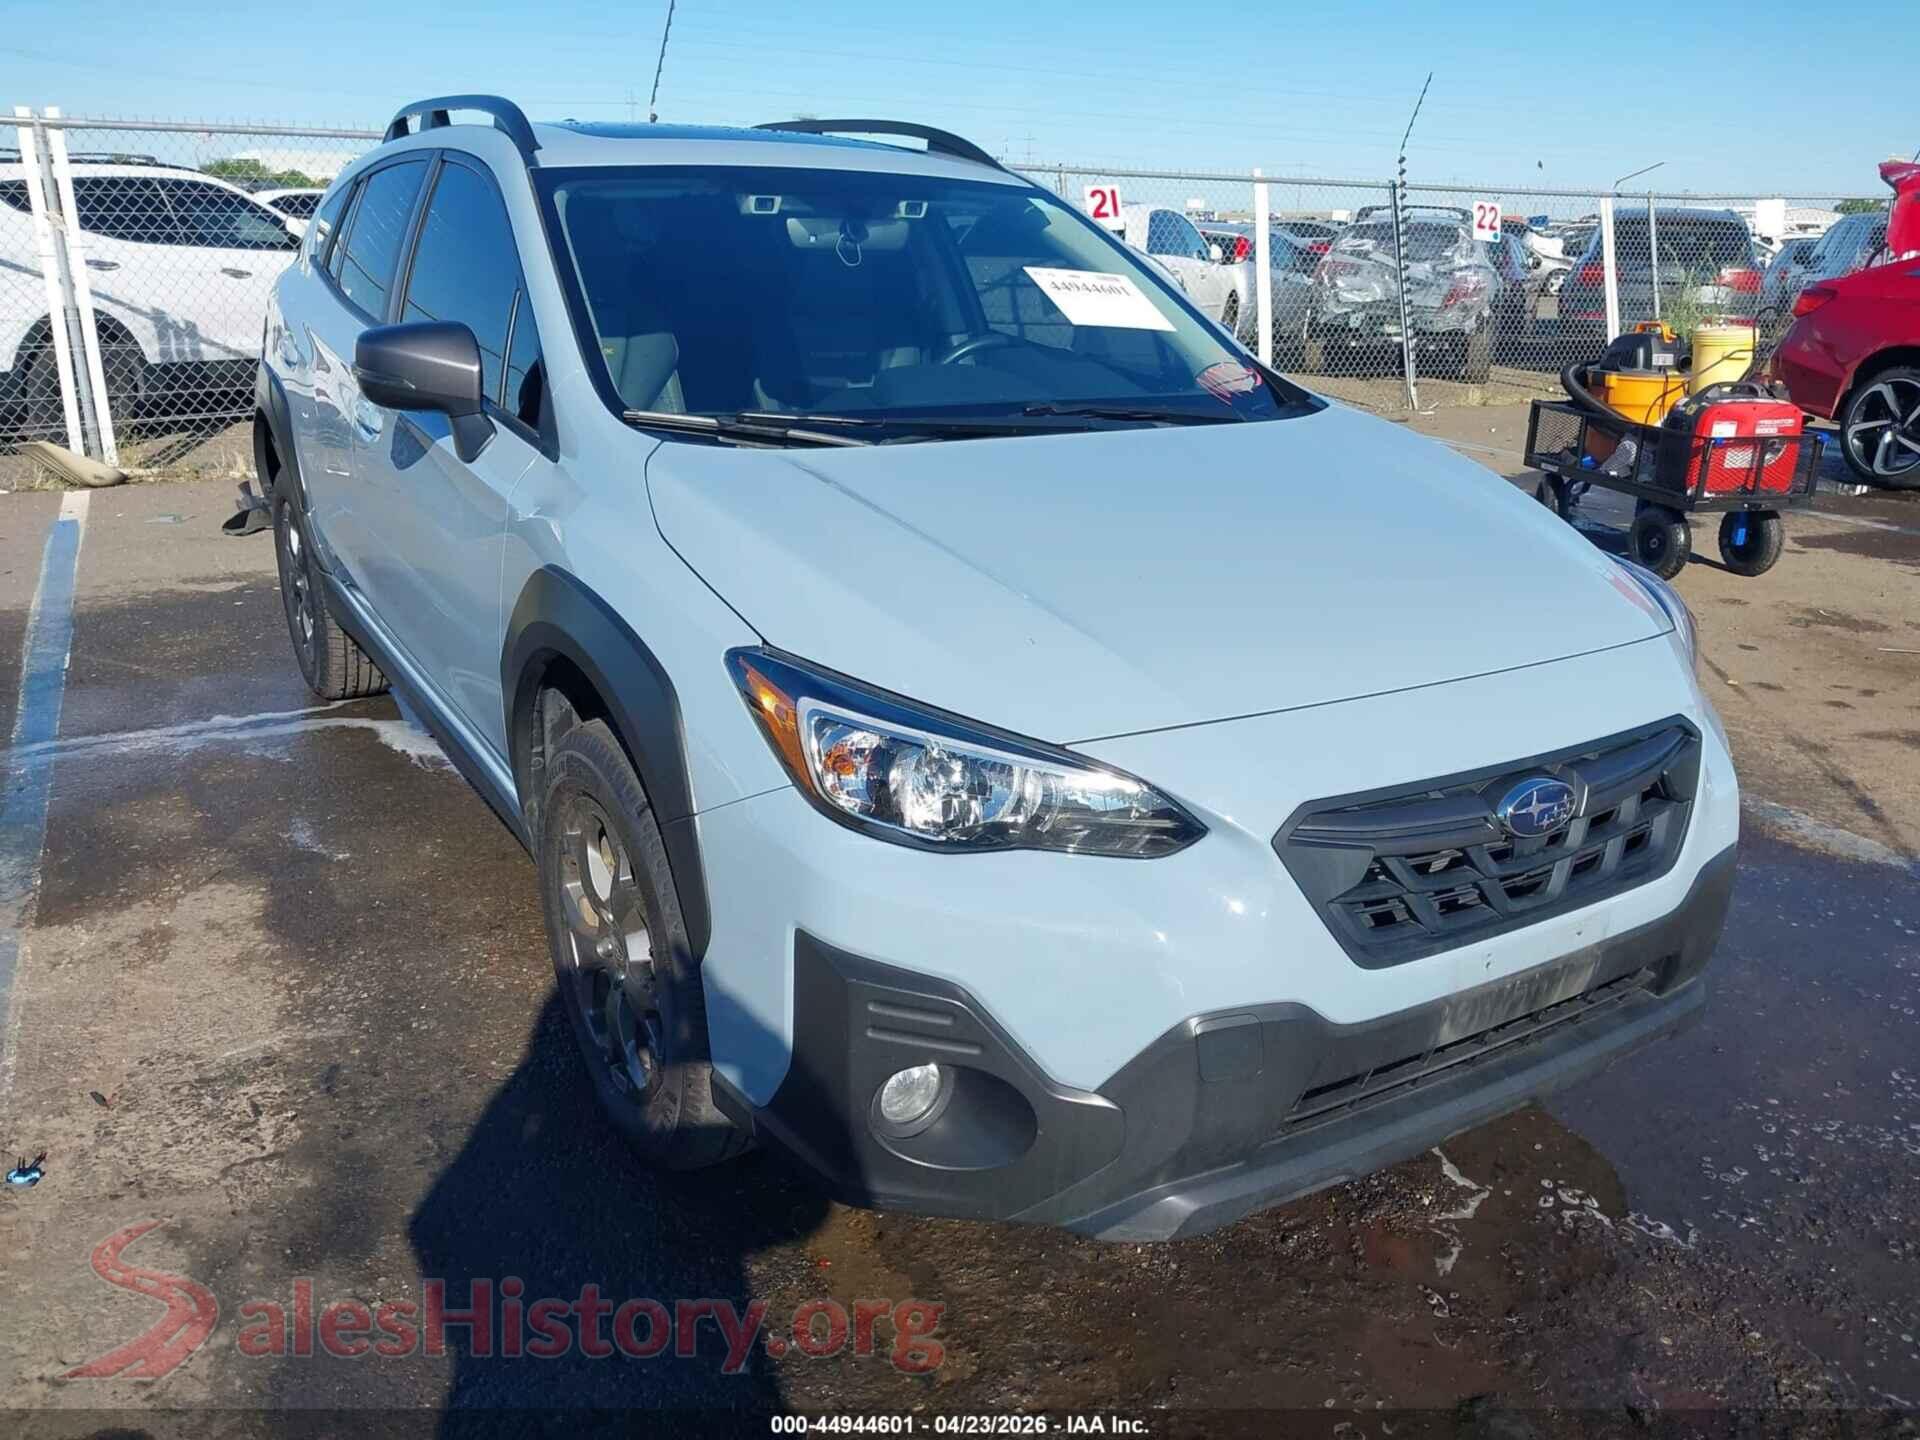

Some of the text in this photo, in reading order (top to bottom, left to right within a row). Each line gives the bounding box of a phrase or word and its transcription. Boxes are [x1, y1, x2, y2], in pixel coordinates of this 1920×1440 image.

[1089, 189, 1120, 219] 21
[1477, 204, 1498, 231] 22
[1050, 280, 1131, 297] 44944601
